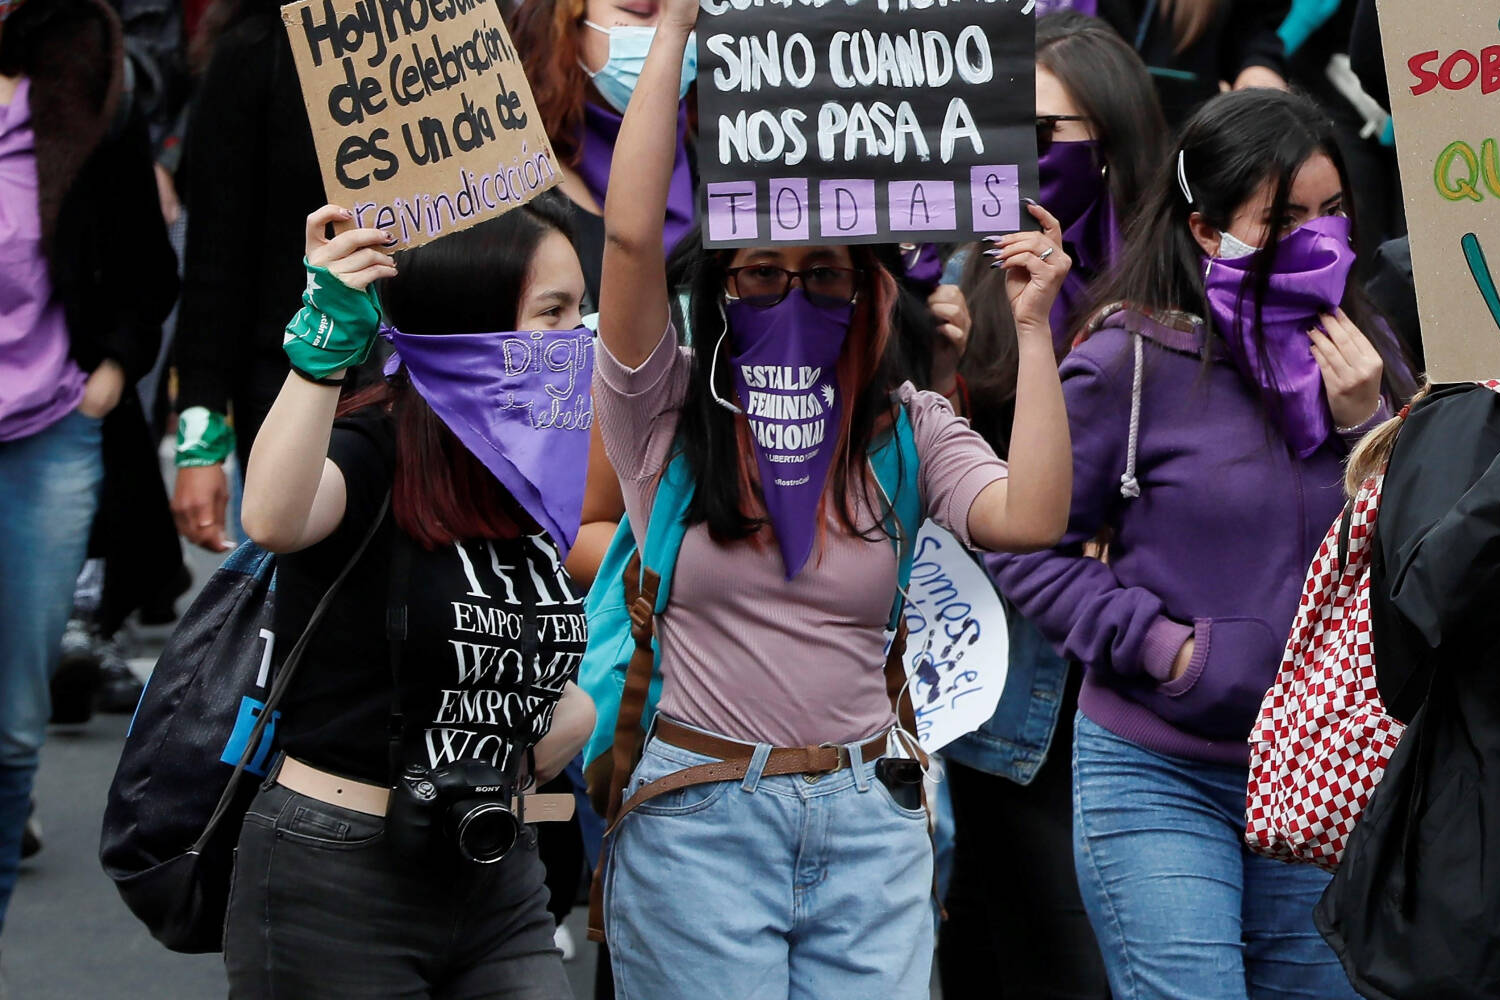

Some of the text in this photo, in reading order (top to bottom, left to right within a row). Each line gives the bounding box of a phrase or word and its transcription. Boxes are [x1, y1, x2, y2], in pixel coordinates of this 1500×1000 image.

[327, 56, 388, 127] de
[706, 24, 994, 93] SINO CUANDO
[334, 127, 400, 190] es
[400, 115, 454, 167] un
[495, 72, 528, 132] de
[718, 96, 985, 166] NOS PASA A
